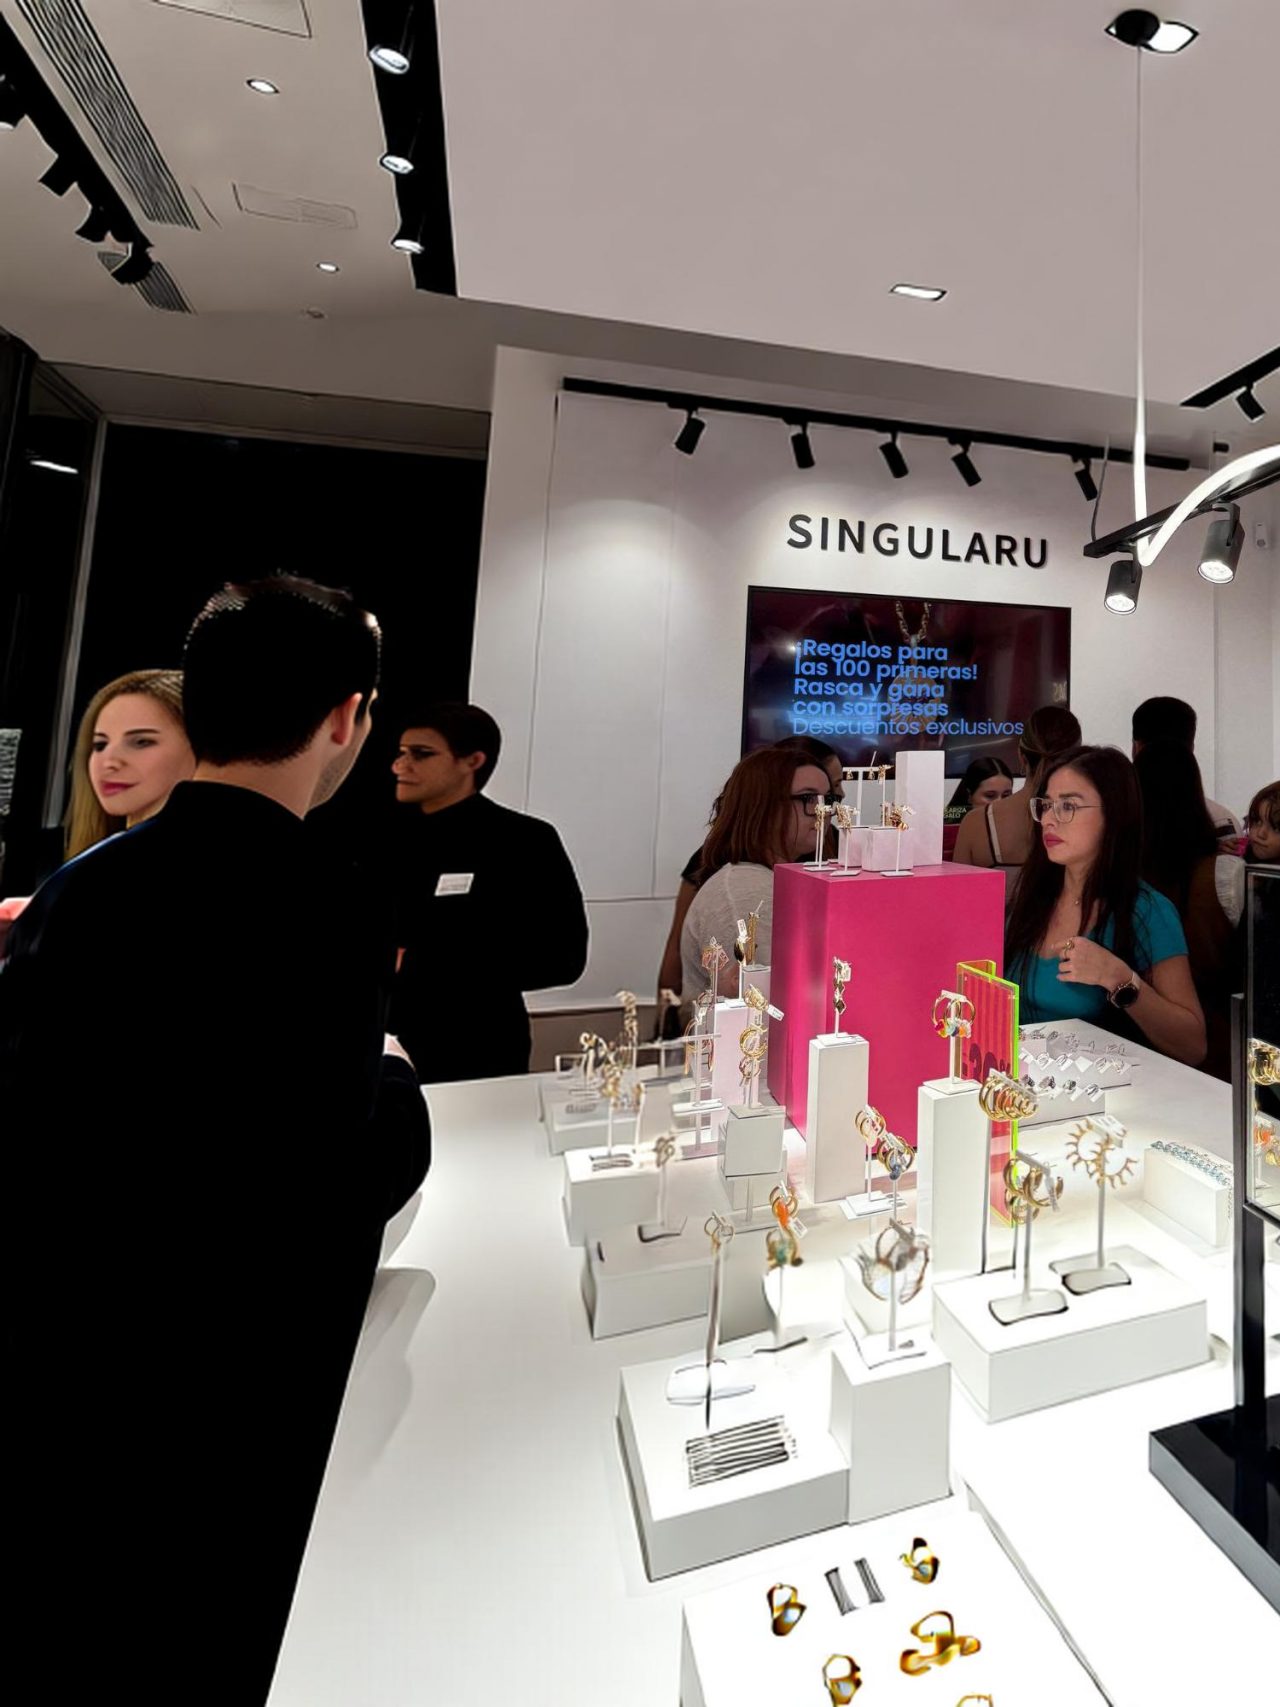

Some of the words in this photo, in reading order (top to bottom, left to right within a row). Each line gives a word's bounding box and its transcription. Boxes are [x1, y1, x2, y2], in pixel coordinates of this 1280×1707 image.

[786, 513, 1048, 569] SINGULARU
[796, 639, 892, 662] ¡Regalos
[898, 646, 948, 665] para
[794, 658, 829, 676] las
[834, 659, 871, 677] 100
[876, 664, 978, 683] primeras!
[794, 678, 864, 696] Rasca
[868, 683, 883, 702] y
[887, 683, 945, 703] gana
[793, 700, 836, 716] con
[842, 701, 949, 721] sorpresas
[793, 718, 921, 735] Descuentos
[925, 717, 1025, 736] exclusivos
